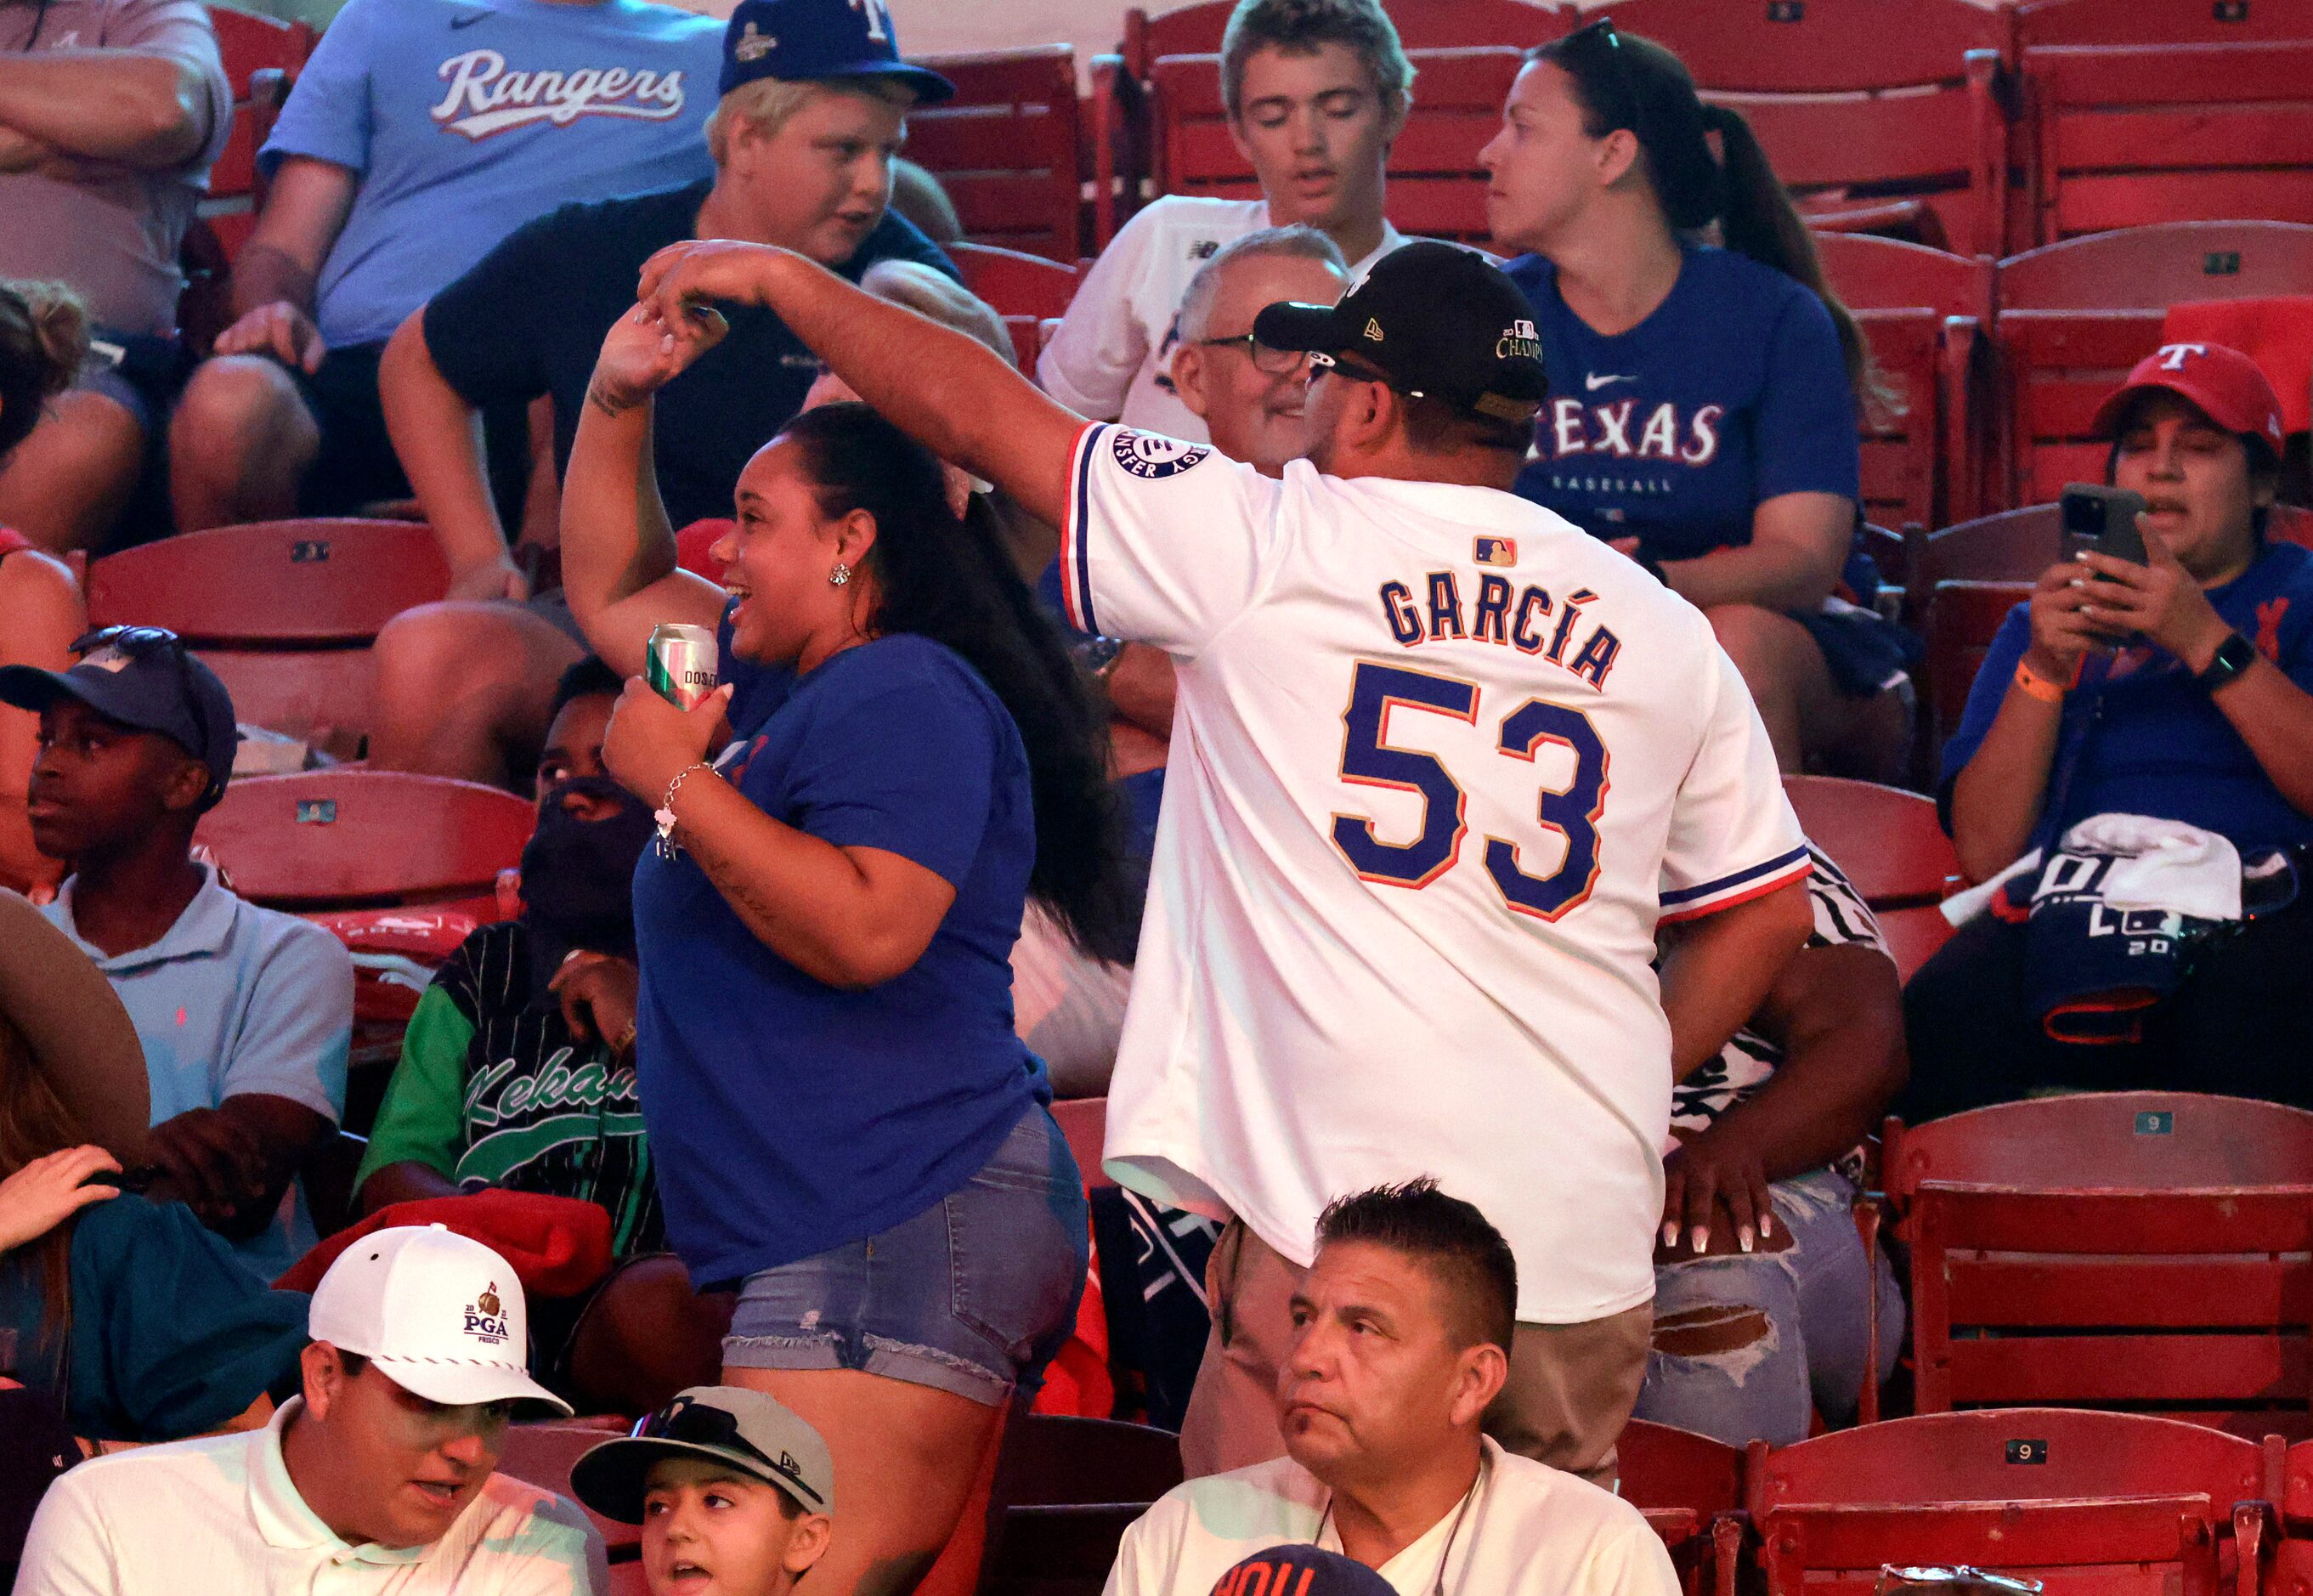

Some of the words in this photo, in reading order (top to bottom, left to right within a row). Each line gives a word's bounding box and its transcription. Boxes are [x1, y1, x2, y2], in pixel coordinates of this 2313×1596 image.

[431, 48, 686, 136] Rangers
[2157, 343, 2209, 372] T
[1552, 474, 1672, 492] BASEBALL
[1378, 571, 1622, 693] GARCÍA
[1330, 659, 1611, 924] 53
[2148, 1115, 2160, 1131] 9
[464, 1315, 509, 1337] PGA
[2019, 1444, 2032, 1460] 9
